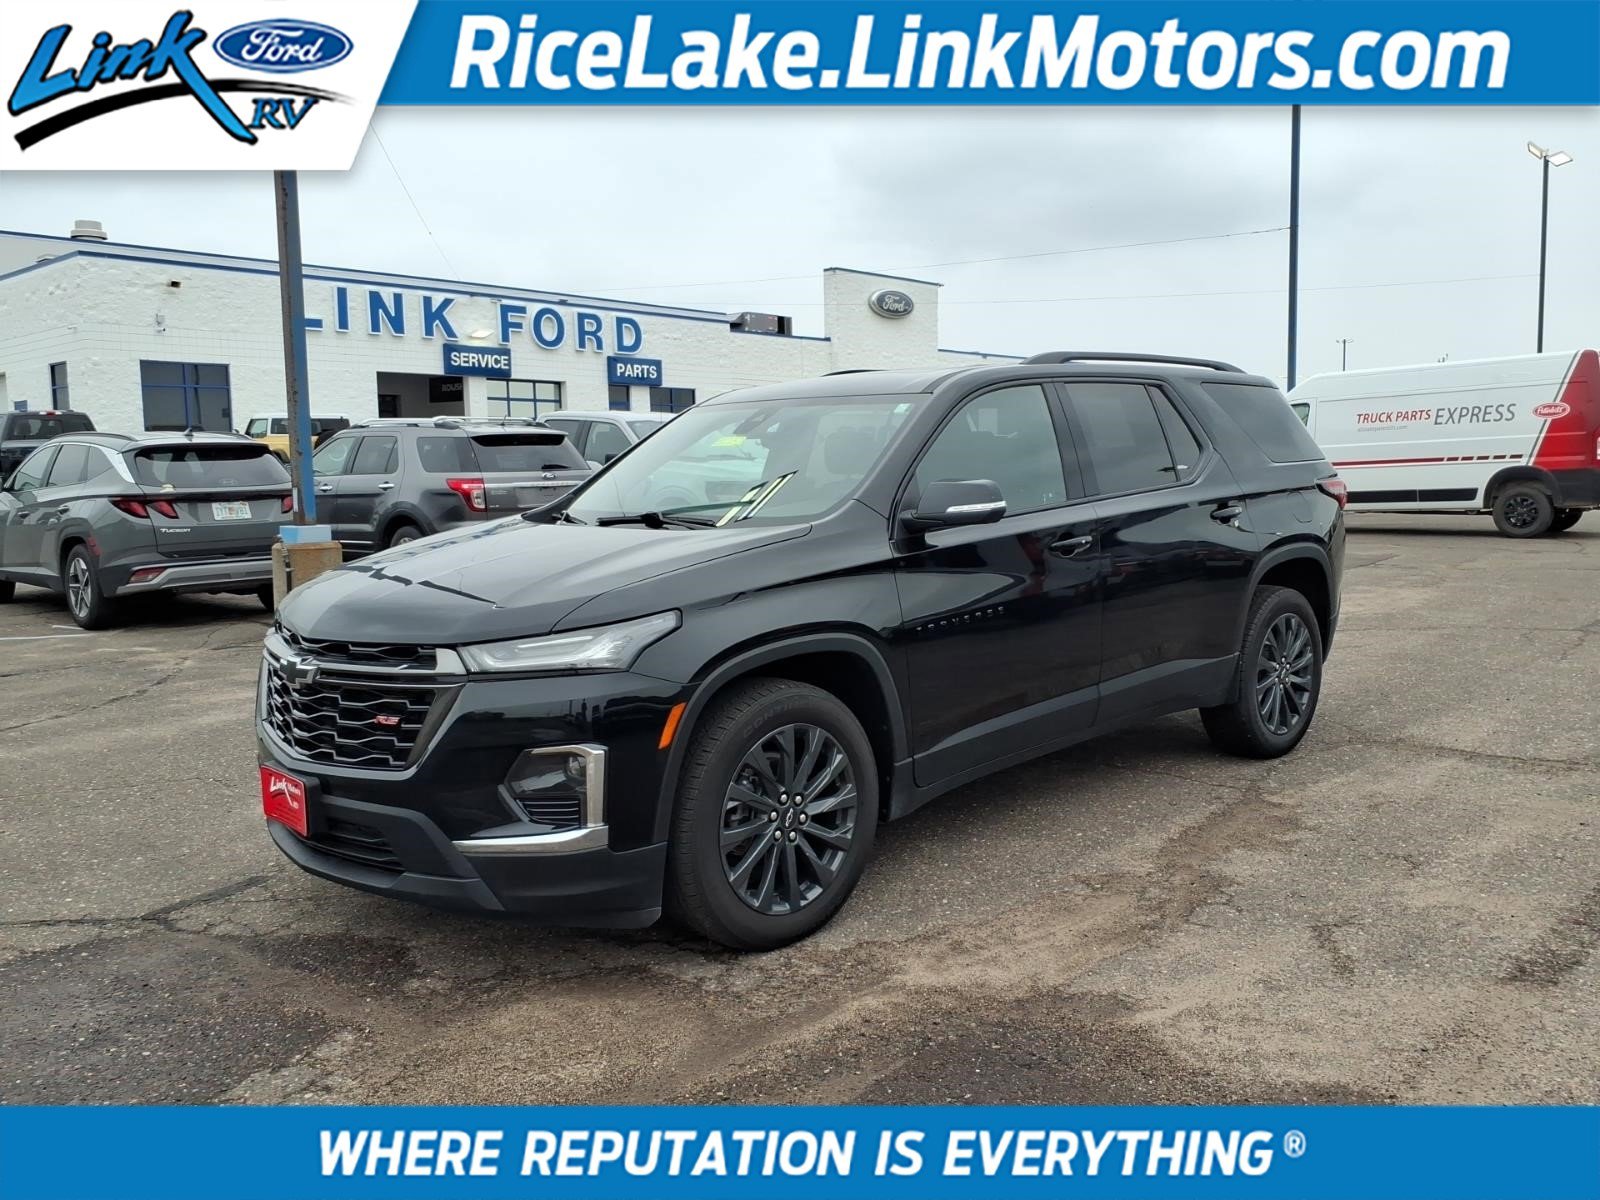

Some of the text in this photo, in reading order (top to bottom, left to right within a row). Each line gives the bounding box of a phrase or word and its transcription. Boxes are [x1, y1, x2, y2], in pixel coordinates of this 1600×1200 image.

[882, 295, 905, 311] Ford
[500, 303, 643, 355] FORD
[451, 352, 510, 370] SERVICE
[616, 363, 658, 379] PARTS
[1356, 403, 1517, 425] TRUCK PARTS EXPRESS
